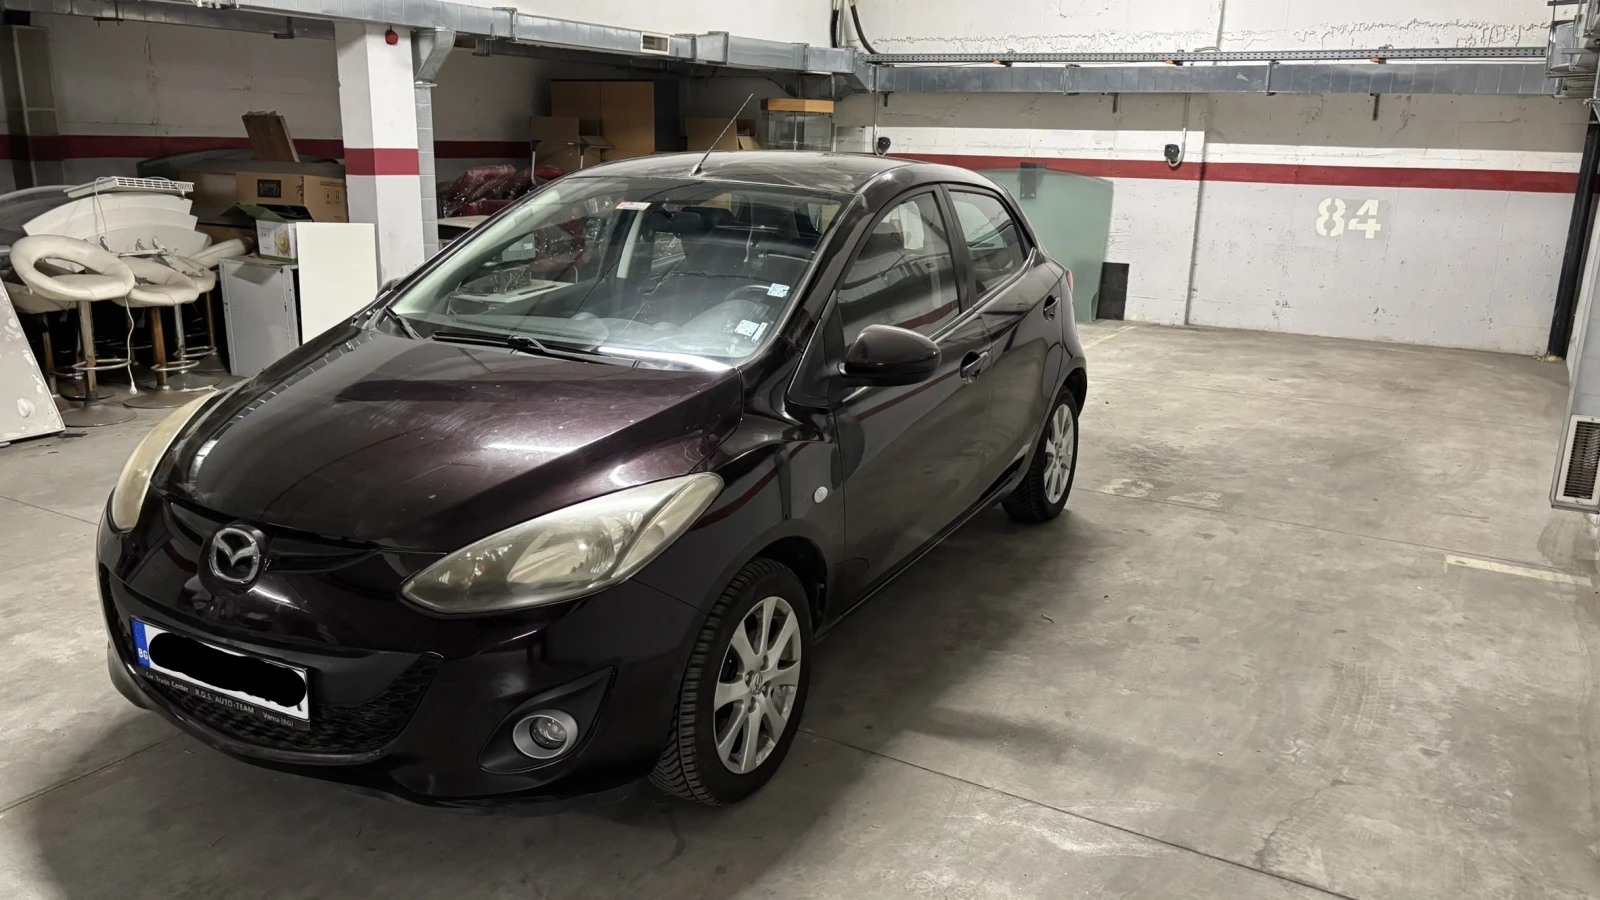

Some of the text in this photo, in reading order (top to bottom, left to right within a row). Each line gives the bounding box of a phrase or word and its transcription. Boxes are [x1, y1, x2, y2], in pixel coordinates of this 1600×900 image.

[1315, 197, 1381, 239] 84
[138, 647, 149, 660] BG
[171, 681, 189, 692] Center
[262, 711, 280, 723] Varna
